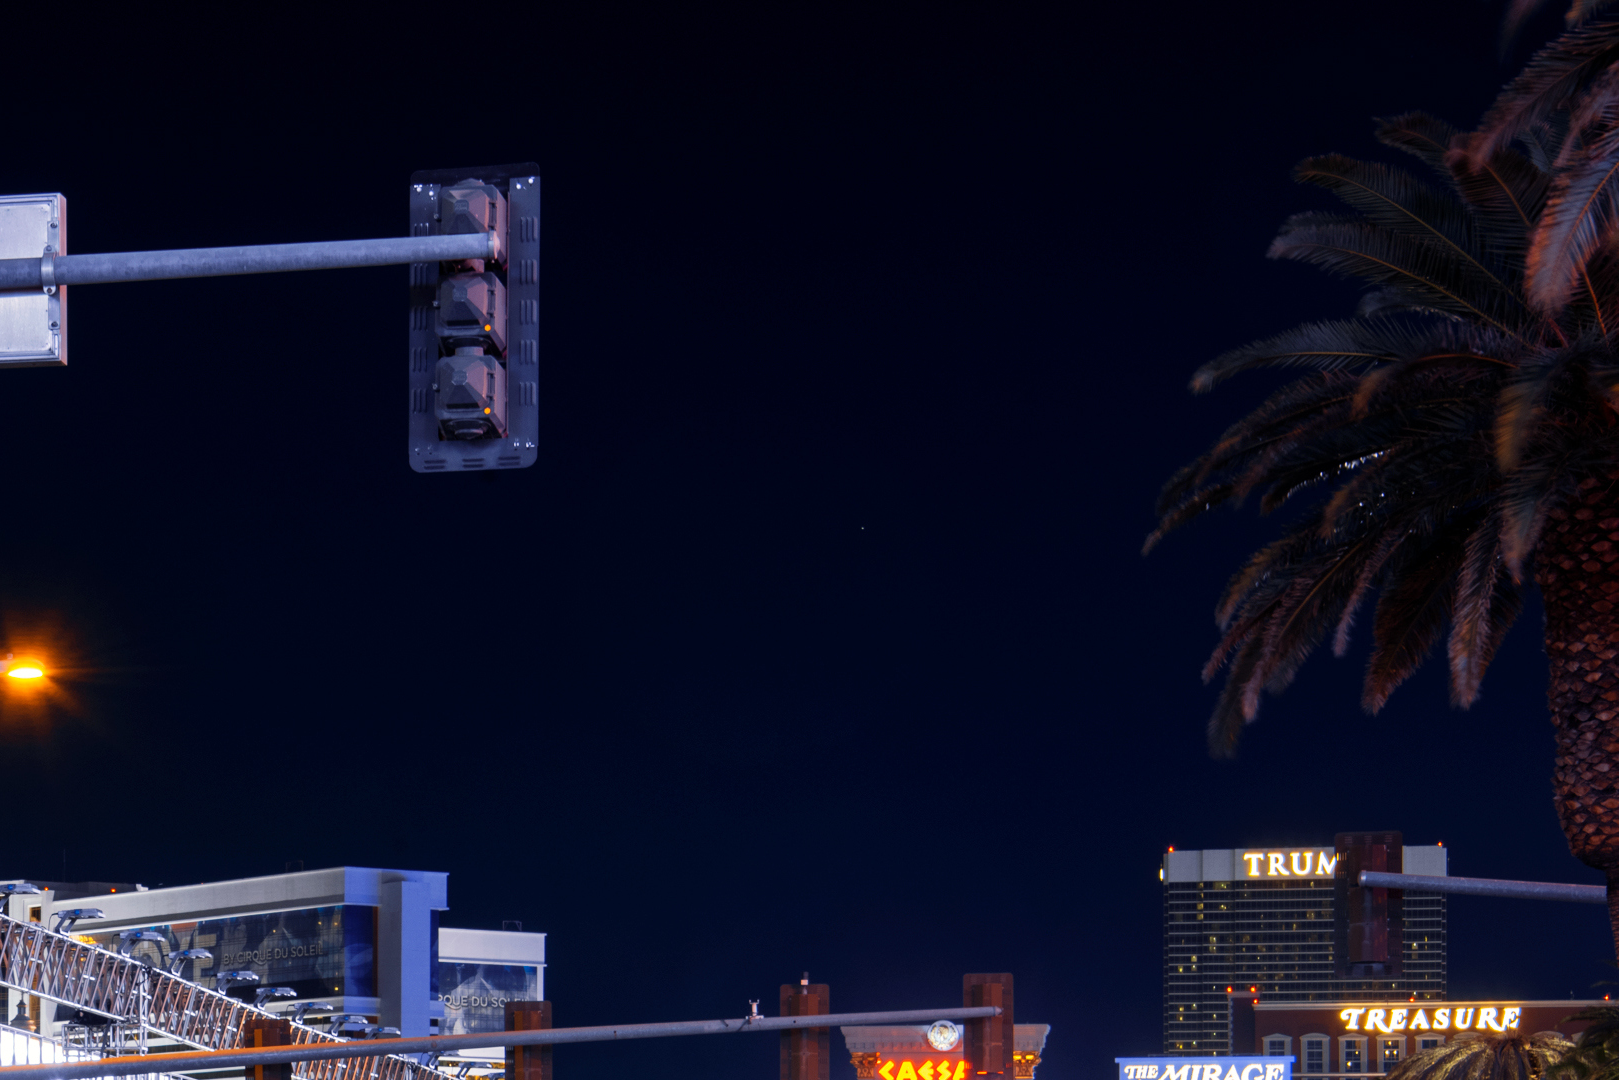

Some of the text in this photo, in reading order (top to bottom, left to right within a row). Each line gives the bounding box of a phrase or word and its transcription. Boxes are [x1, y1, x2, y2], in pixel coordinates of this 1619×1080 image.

[1243, 851, 1337, 876] TRUM
[236, 949, 273, 966] CIRQUE
[274, 947, 289, 959] DU
[290, 943, 324, 958] SOLEIL
[472, 996, 488, 1007] DU
[1339, 1007, 1522, 1033] TREASURE
[1124, 1065, 1158, 1079] THE
